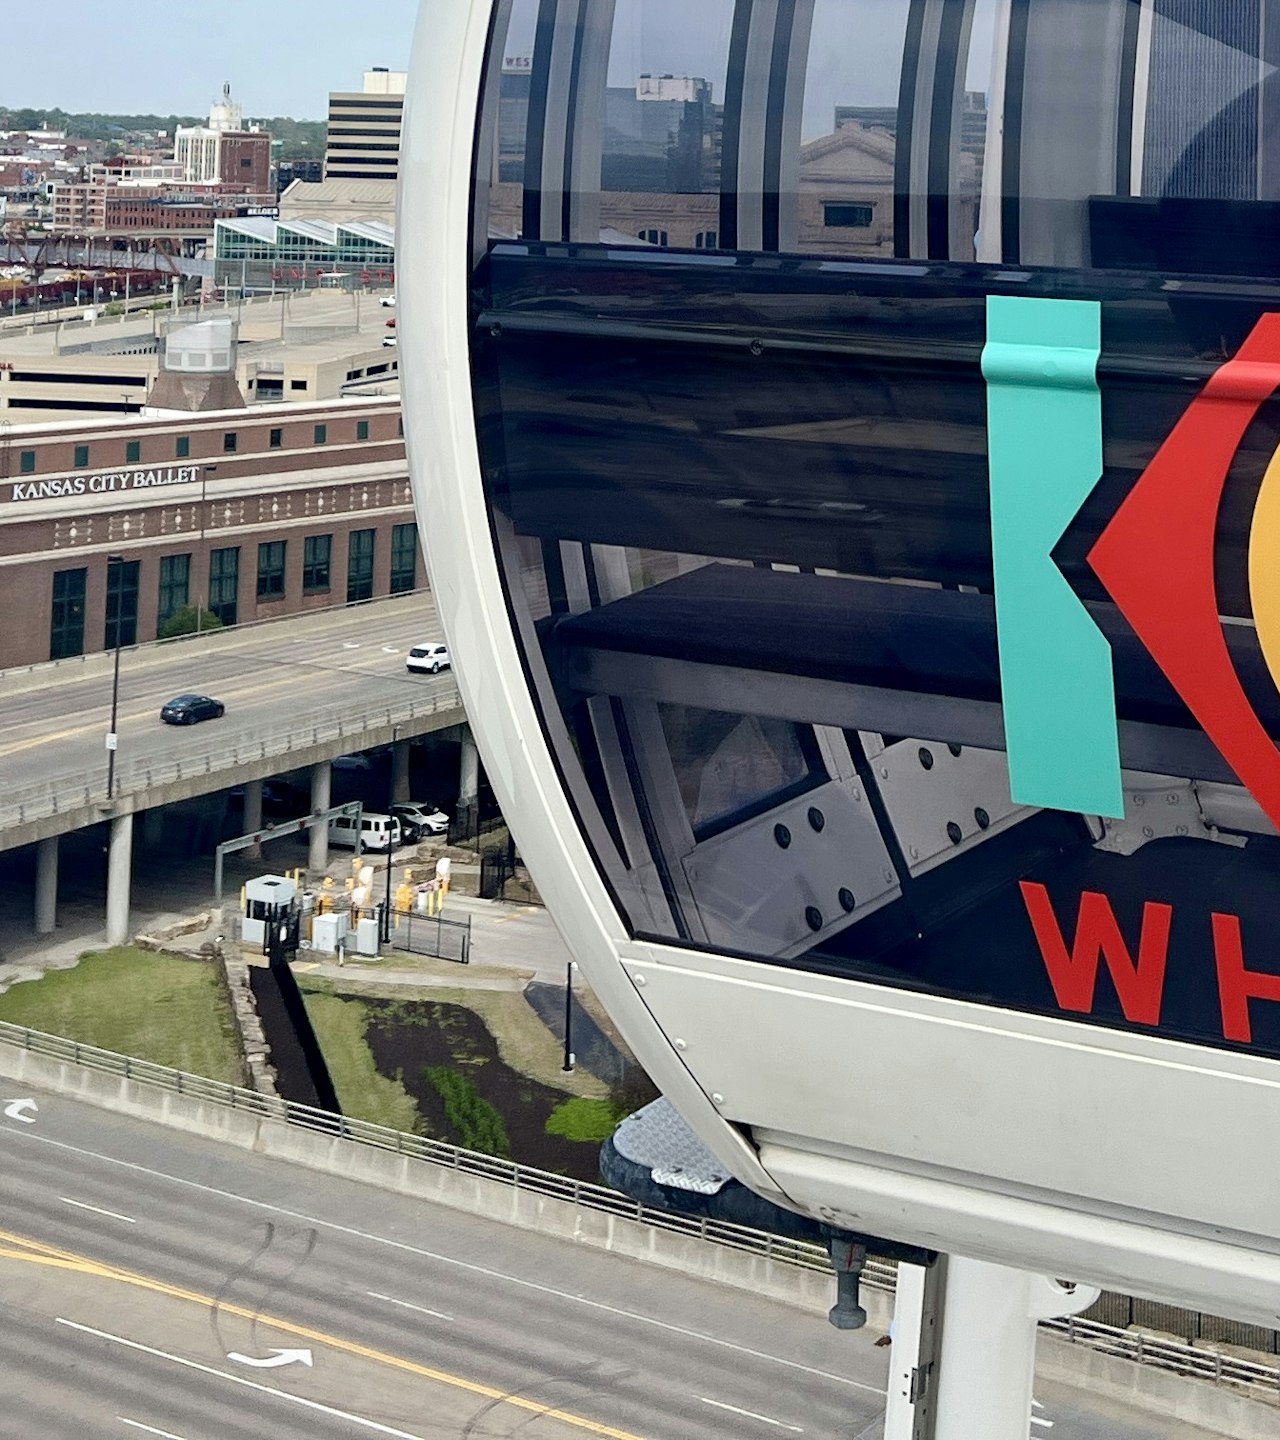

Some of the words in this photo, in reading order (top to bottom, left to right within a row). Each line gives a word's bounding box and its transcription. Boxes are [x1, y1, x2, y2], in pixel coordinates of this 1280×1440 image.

[505, 56, 531, 67] WES
[12, 477, 86, 501] KANSAS
[89, 473, 133, 492] CITY
[133, 466, 200, 488] BALLET
